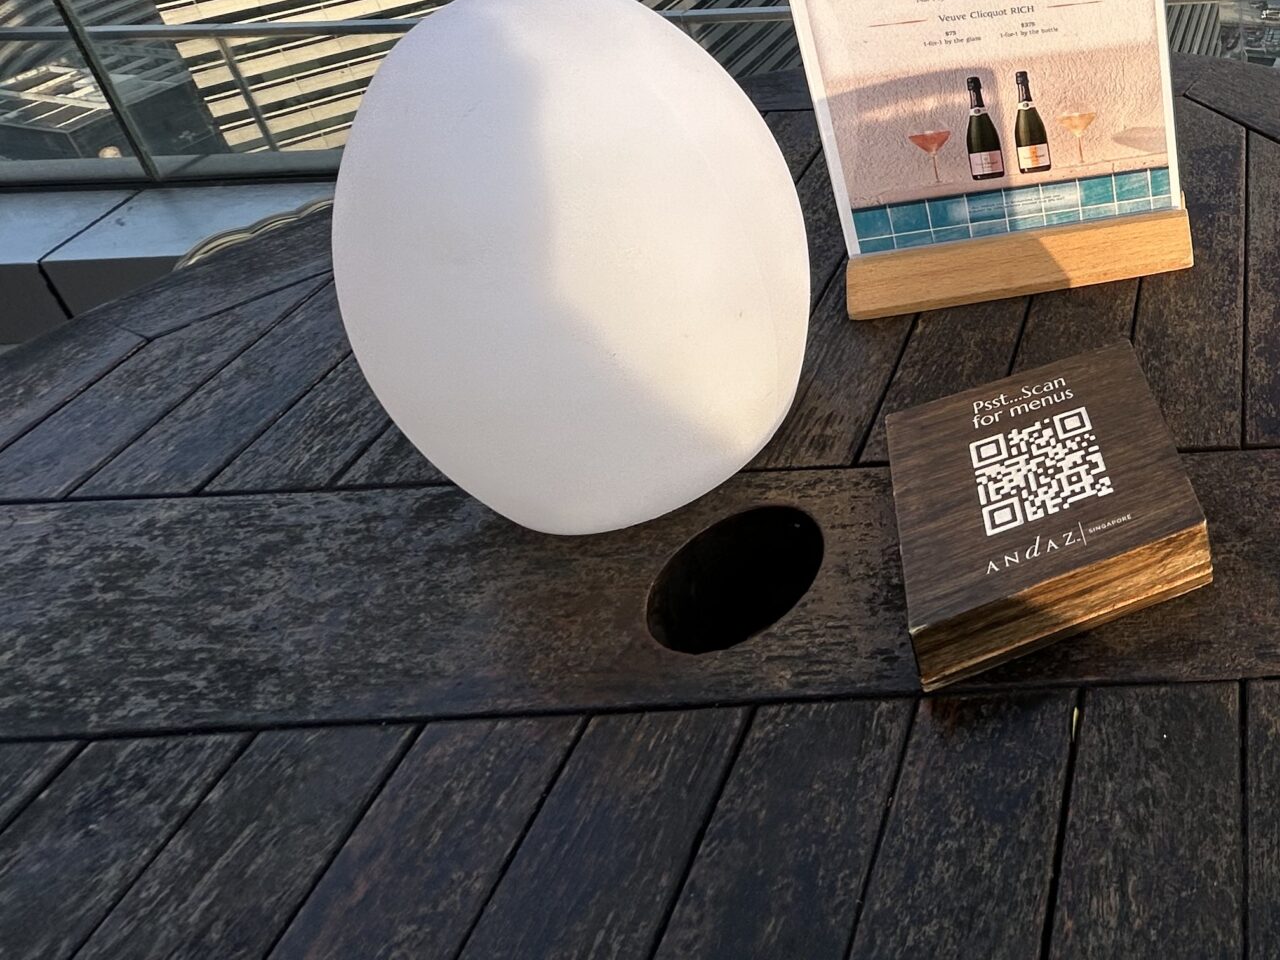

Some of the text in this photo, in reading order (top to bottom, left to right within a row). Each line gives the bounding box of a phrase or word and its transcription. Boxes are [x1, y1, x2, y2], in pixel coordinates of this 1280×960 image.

[938, 5, 1035, 22] Veuve Clicquot RICH
[972, 389, 1074, 429] for menus
[1088, 513, 1132, 534] SINGAPORE
